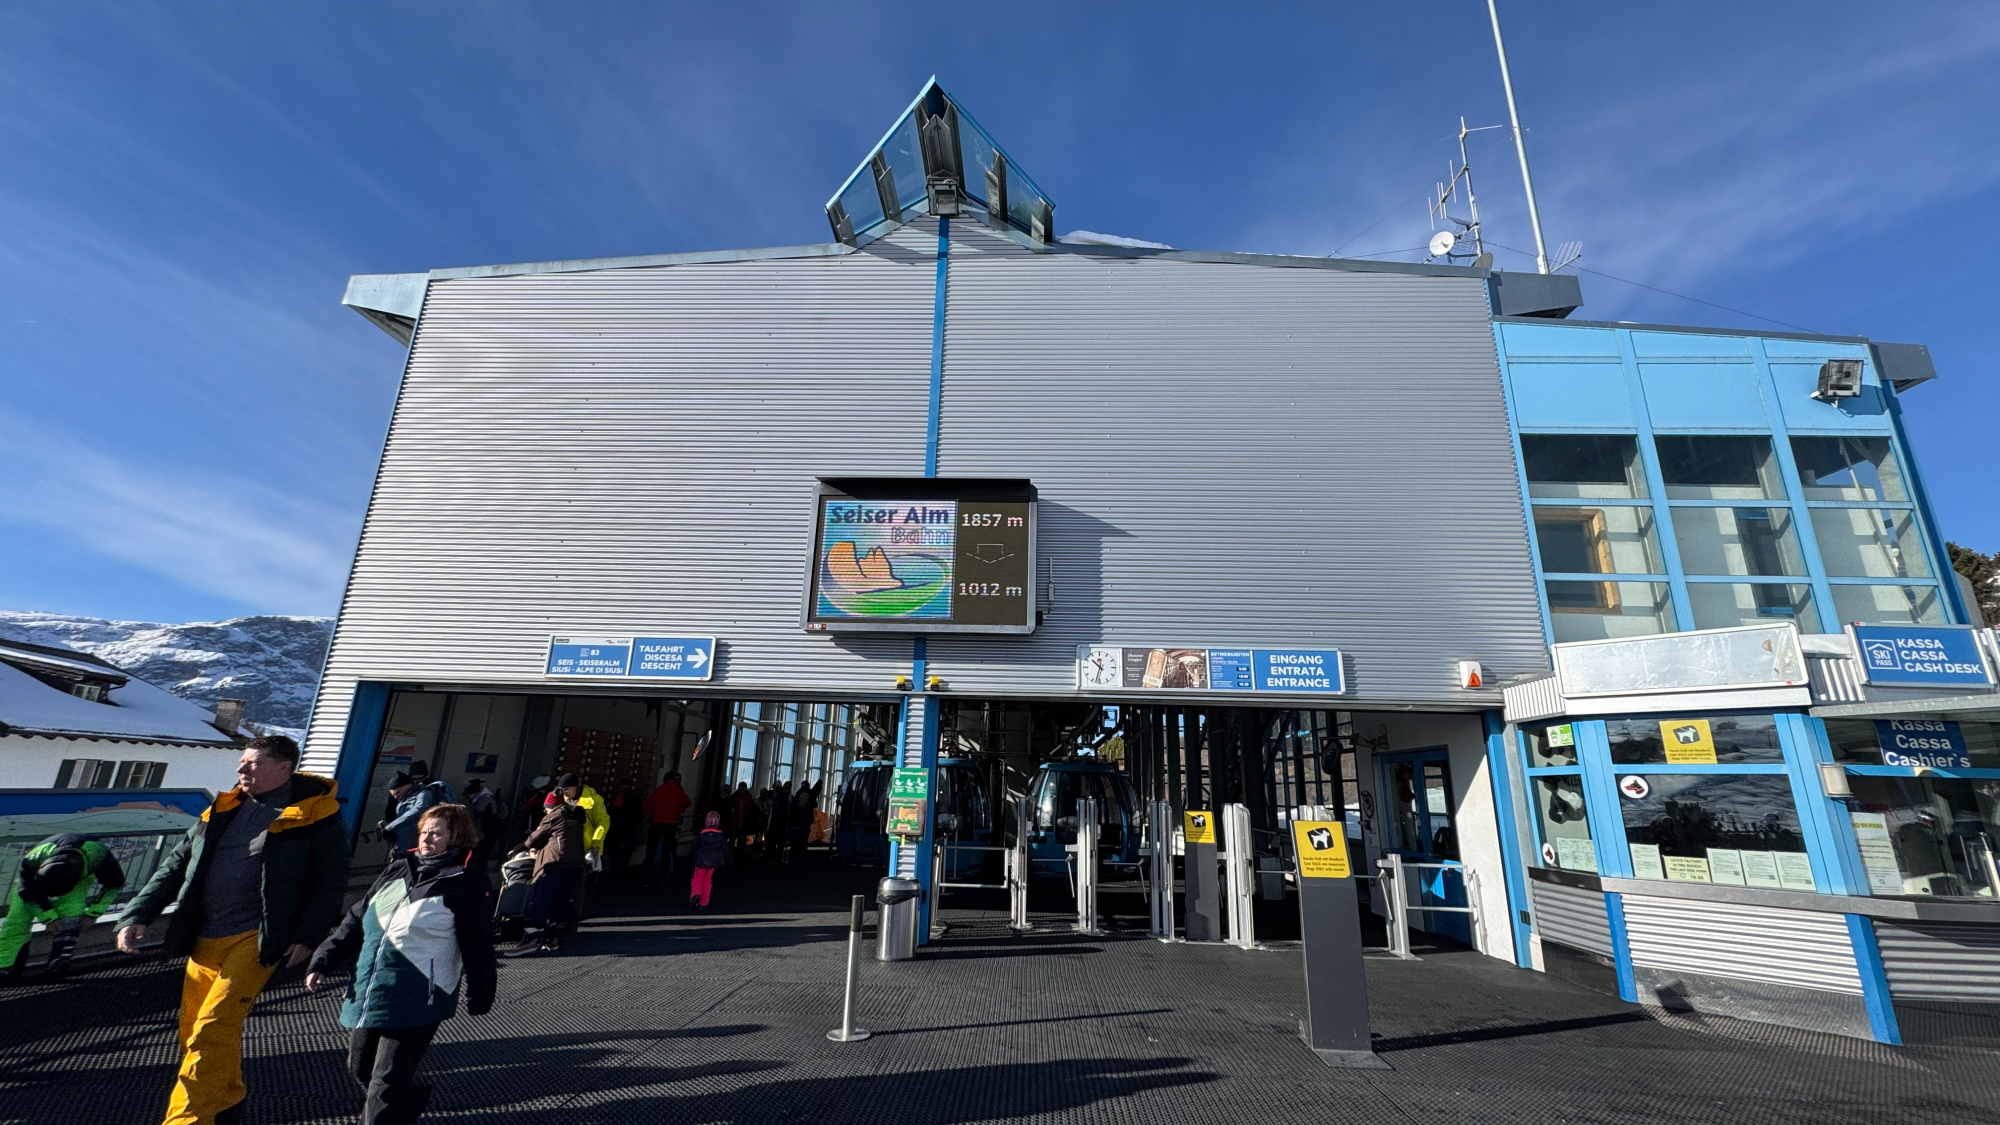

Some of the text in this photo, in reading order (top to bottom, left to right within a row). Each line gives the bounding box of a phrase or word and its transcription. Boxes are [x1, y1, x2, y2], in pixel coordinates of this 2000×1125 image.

[829, 504, 949, 525] Seiser Alm
[961, 513, 1024, 527] 1857 m
[891, 527, 949, 544] Bahn
[959, 582, 1022, 597] 1012 m
[639, 645, 685, 653] TALFAHRT
[1896, 638, 1945, 649] KASSA
[644, 653, 683, 662] DISCESA
[1269, 654, 1324, 665] EINGANG
[1873, 649, 1892, 660] SKI
[1900, 650, 1949, 661] CASSA
[557, 658, 574, 666] SEIS
[579, 659, 620, 667] SEISERALM
[640, 662, 682, 670] DESCENT
[1904, 662, 1983, 674] CASH DESK
[1270, 666, 1325, 676] ENTRATA
[1266, 677, 1331, 688] ENTRANCE
[1891, 720, 1946, 732] Kassa
[1895, 734, 1952, 749] Cassa
